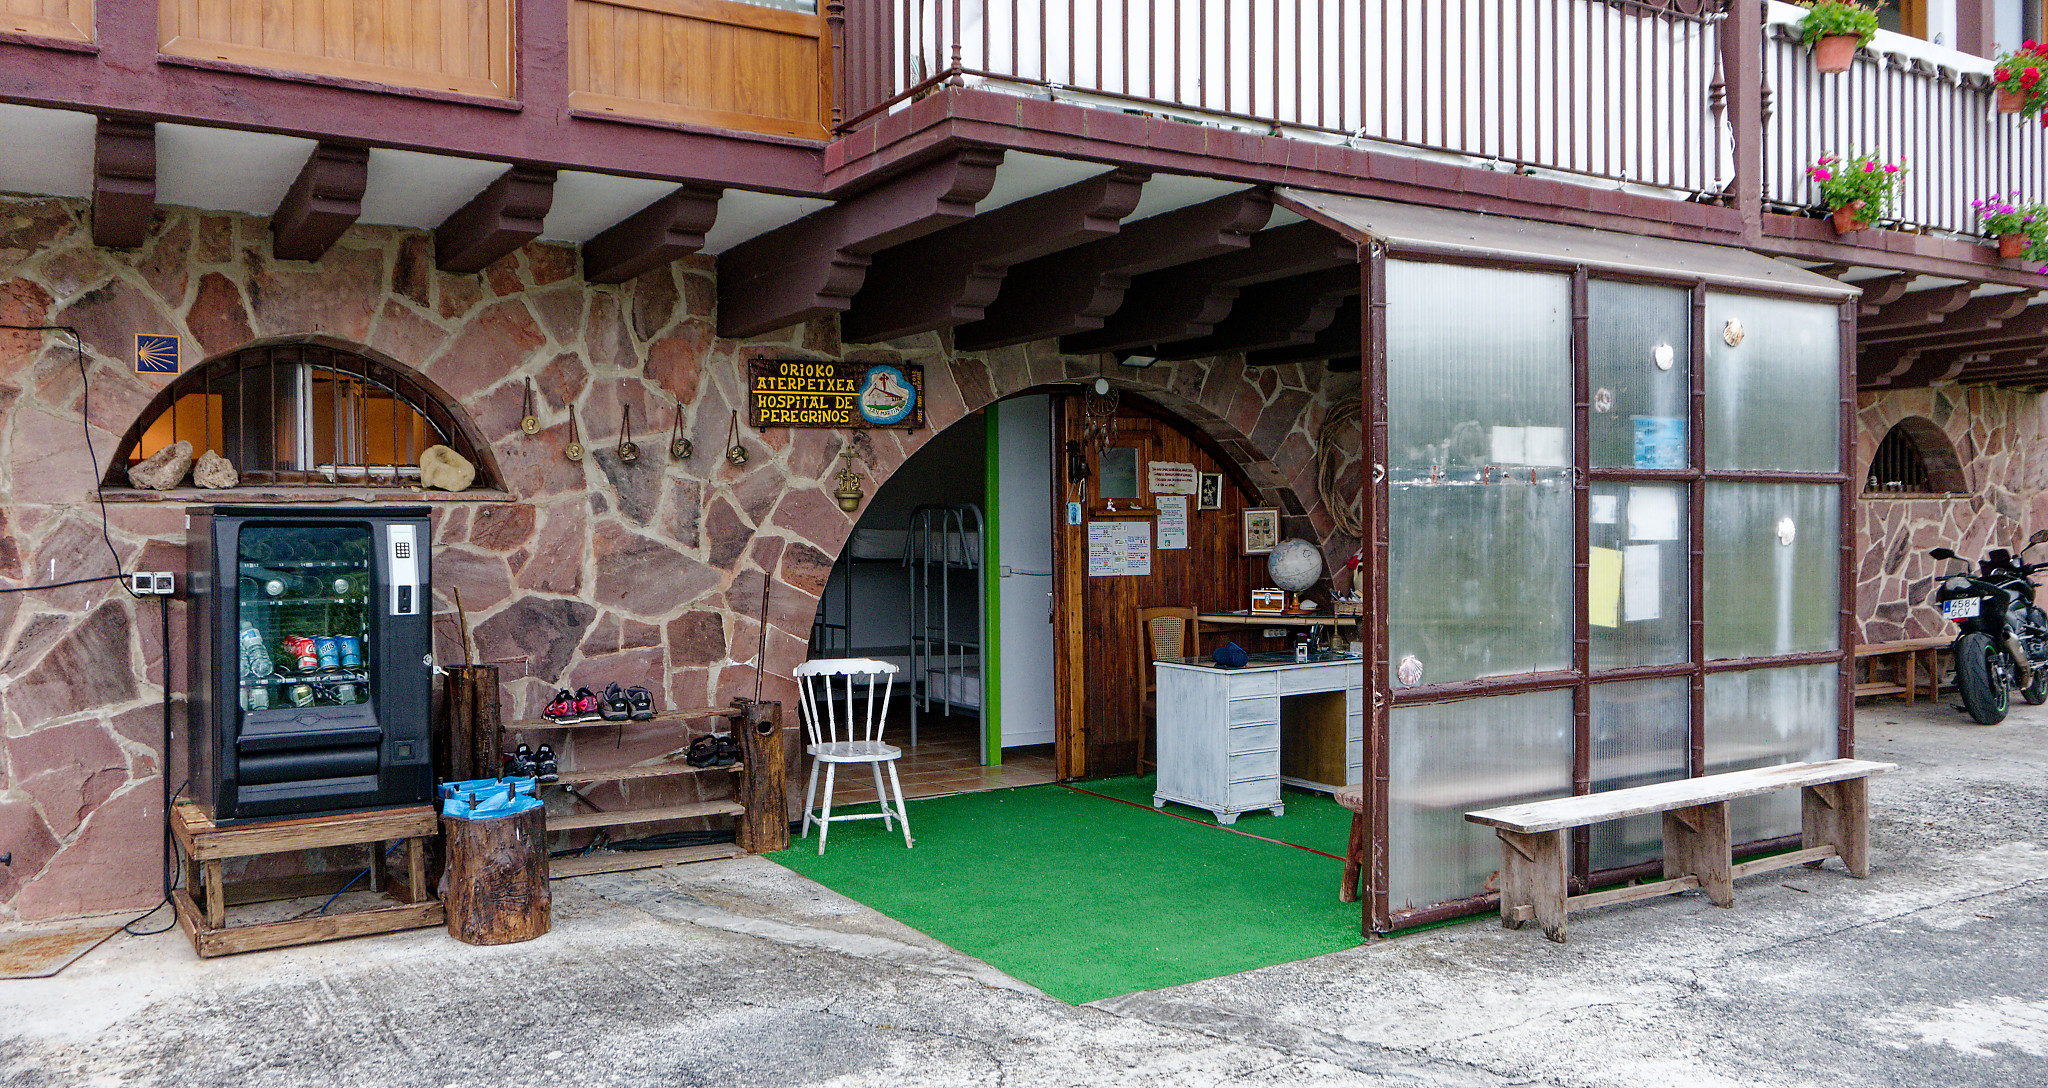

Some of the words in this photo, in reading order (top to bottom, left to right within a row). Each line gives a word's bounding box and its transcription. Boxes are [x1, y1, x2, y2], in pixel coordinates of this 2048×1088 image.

[757, 376, 855, 391] ATERPETXEA
[835, 396, 854, 409] DE
[1951, 597, 1977, 608] 4584
[1951, 607, 1970, 617] GCV
